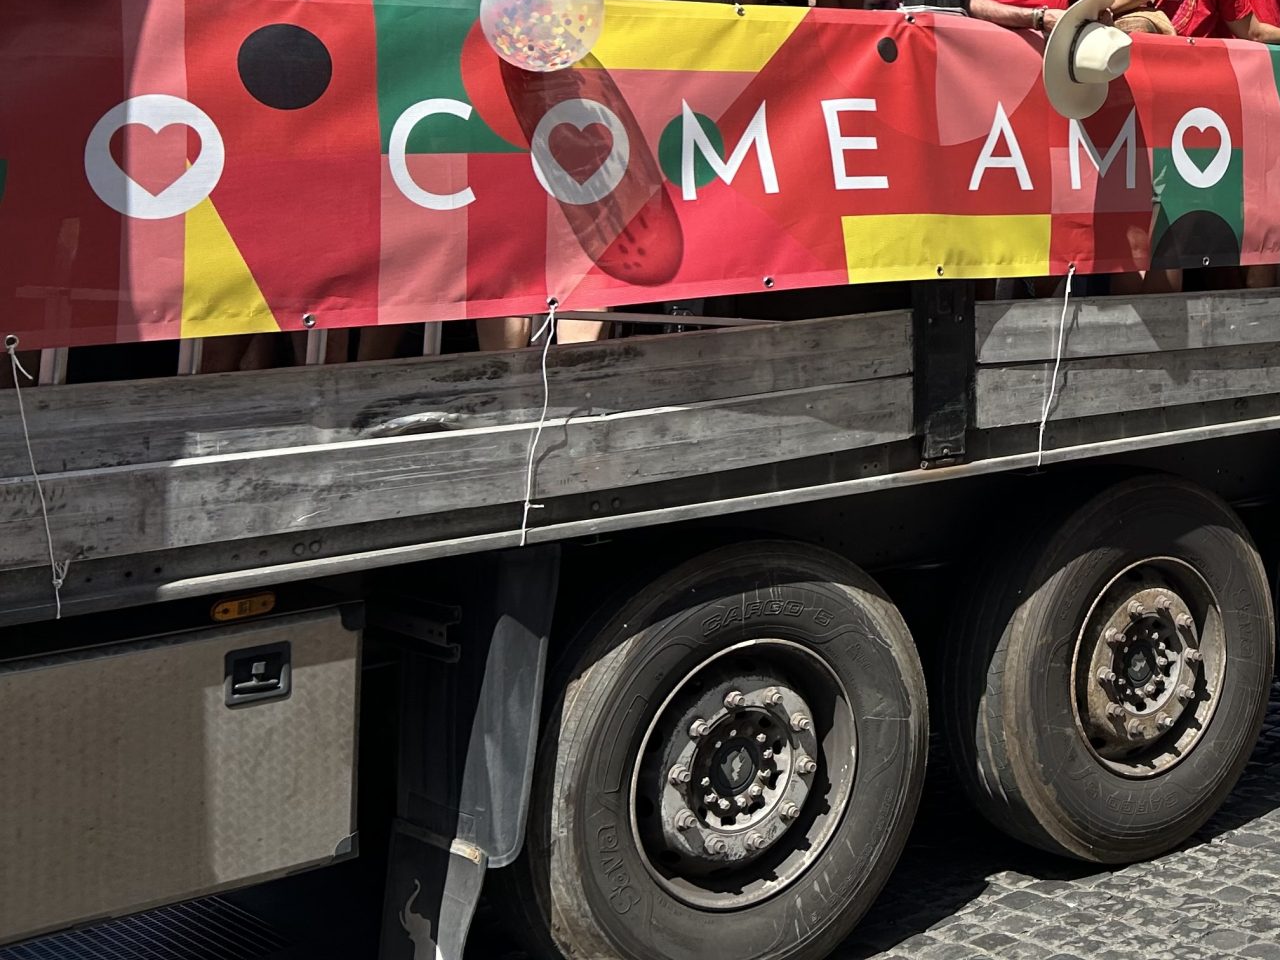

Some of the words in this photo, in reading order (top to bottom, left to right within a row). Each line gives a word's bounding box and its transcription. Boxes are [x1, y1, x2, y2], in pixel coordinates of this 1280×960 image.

[388, 97, 889, 211] COME
[969, 100, 1232, 192] AMO
[700, 599, 804, 637] CARGO
[596, 823, 642, 915] Sava
